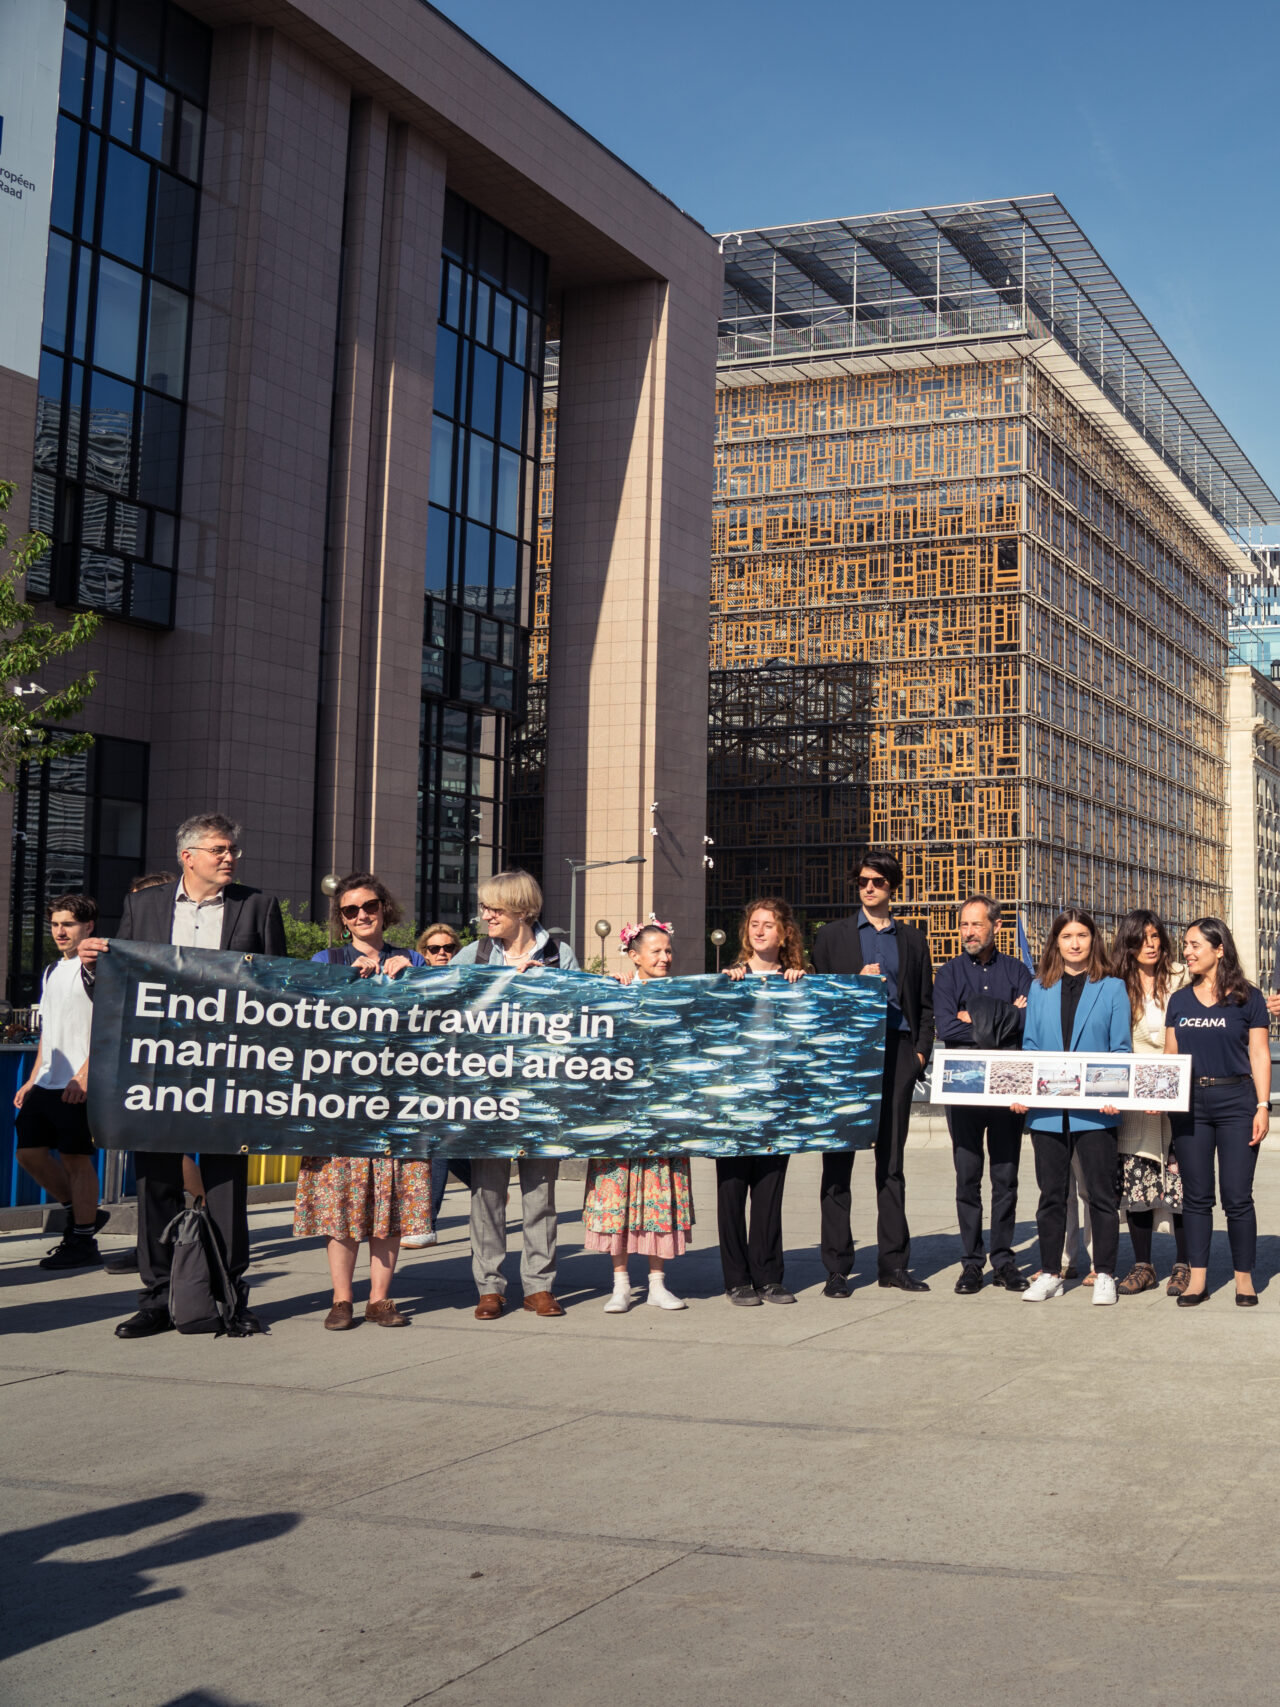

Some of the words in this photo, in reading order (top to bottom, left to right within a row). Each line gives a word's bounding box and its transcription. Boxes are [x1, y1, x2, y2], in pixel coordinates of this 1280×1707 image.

[135, 981, 226, 1023] End
[236, 988, 399, 1033] bottom
[407, 1001, 573, 1045] trawling
[579, 1005, 614, 1039] in
[1179, 1017, 1227, 1028] OCEANA
[130, 1034, 294, 1072] marine
[302, 1045, 513, 1082] protected
[523, 1053, 635, 1081] areas
[124, 1078, 221, 1113] and
[225, 1080, 390, 1120] inshore
[397, 1095, 521, 1121] zones
